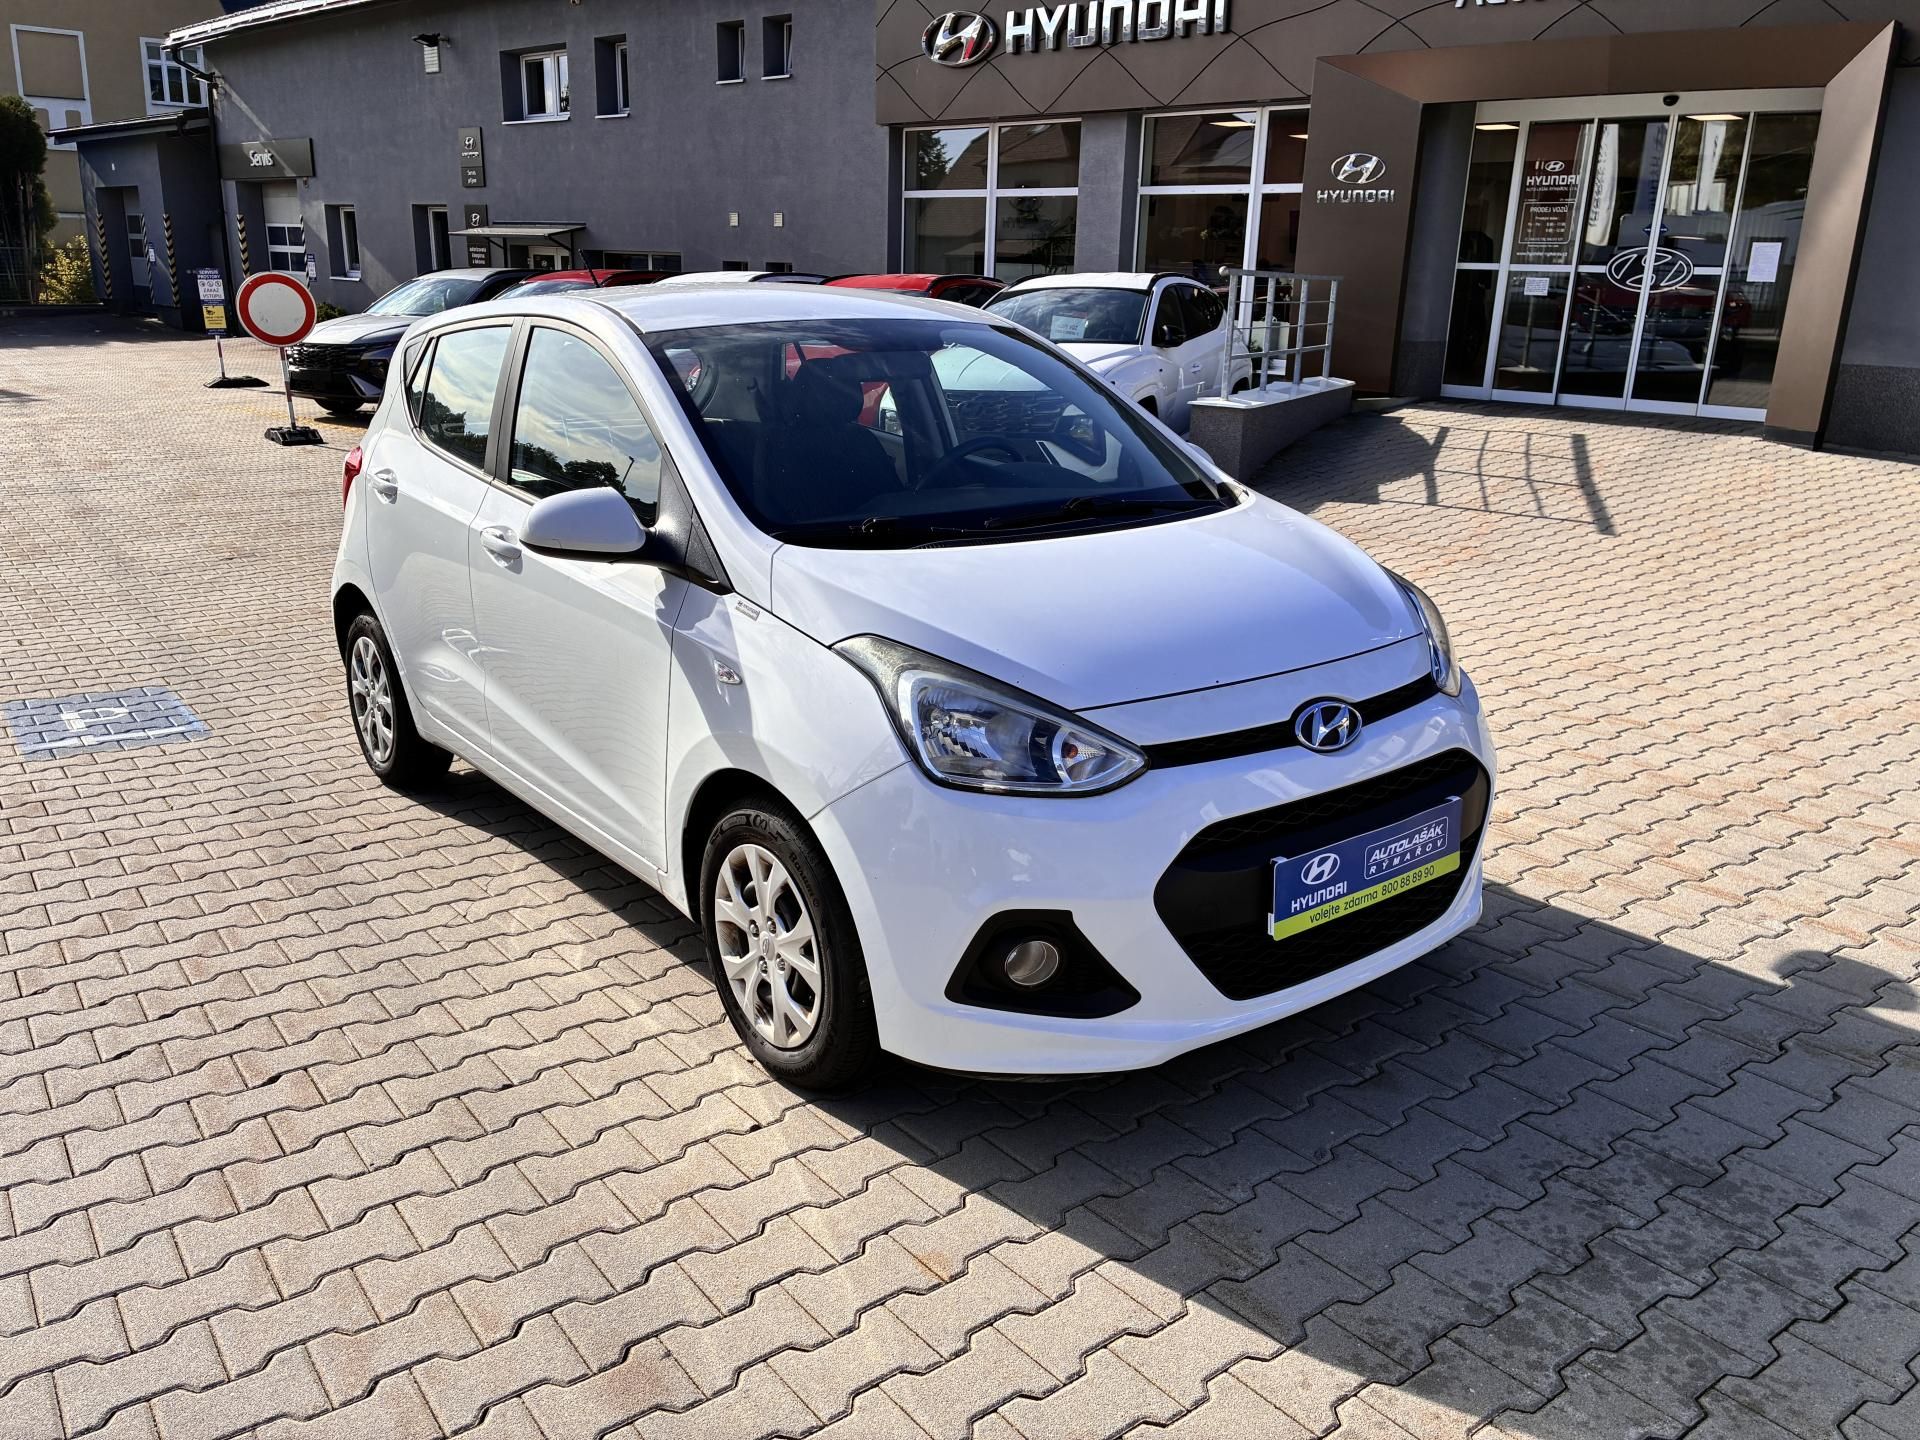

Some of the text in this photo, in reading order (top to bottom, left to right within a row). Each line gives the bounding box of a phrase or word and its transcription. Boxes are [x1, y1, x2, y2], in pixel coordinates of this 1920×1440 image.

[1005, 0, 1228, 53] HYUNDAI
[249, 149, 273, 166] Servis
[1316, 189, 1395, 203] HYUNDAI
[1525, 174, 1579, 186] HYUNDAI
[1369, 824, 1444, 862] AUTOLAŠÁK
[1291, 881, 1347, 913] HYUNDAI
[1309, 865, 1435, 924] volejte zdarma 800 88 89 90
